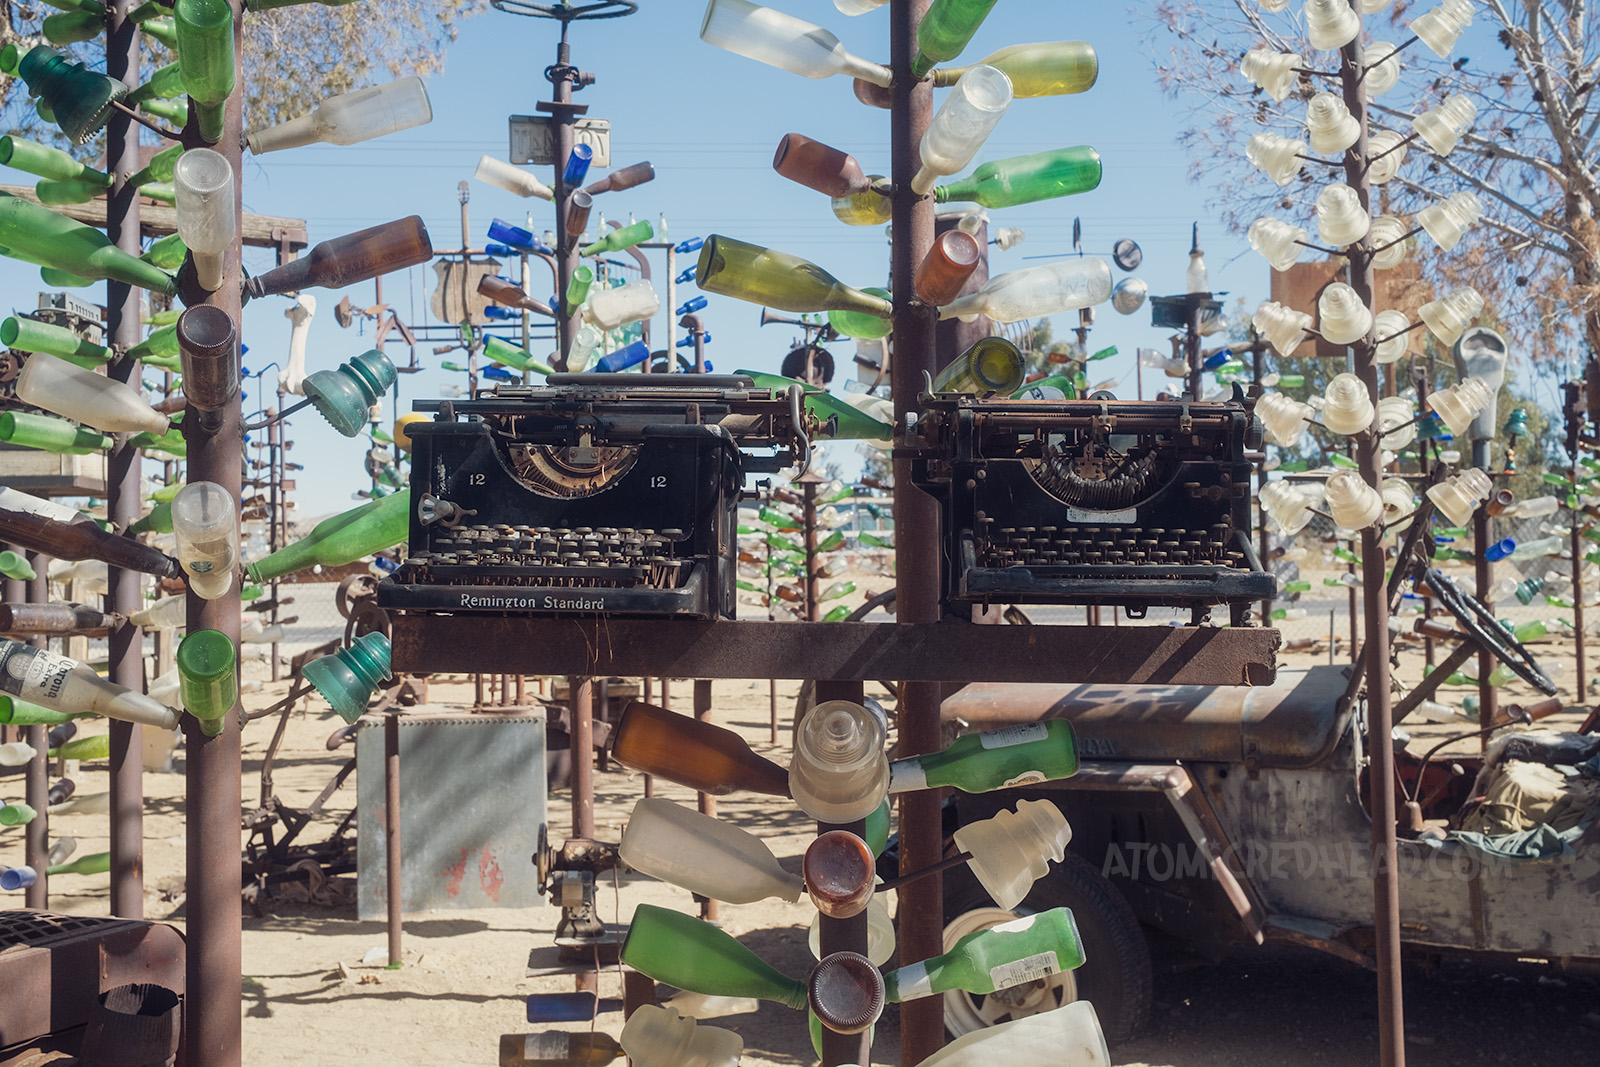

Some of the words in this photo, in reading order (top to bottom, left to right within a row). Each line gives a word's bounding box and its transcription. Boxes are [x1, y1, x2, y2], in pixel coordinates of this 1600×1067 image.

[470, 473, 486, 486] 12
[650, 475, 667, 488] 12
[460, 593, 536, 609] Remington
[543, 595, 605, 610] Standard
[40, 662, 58, 688] Extra
[44, 659, 76, 699] Corona
